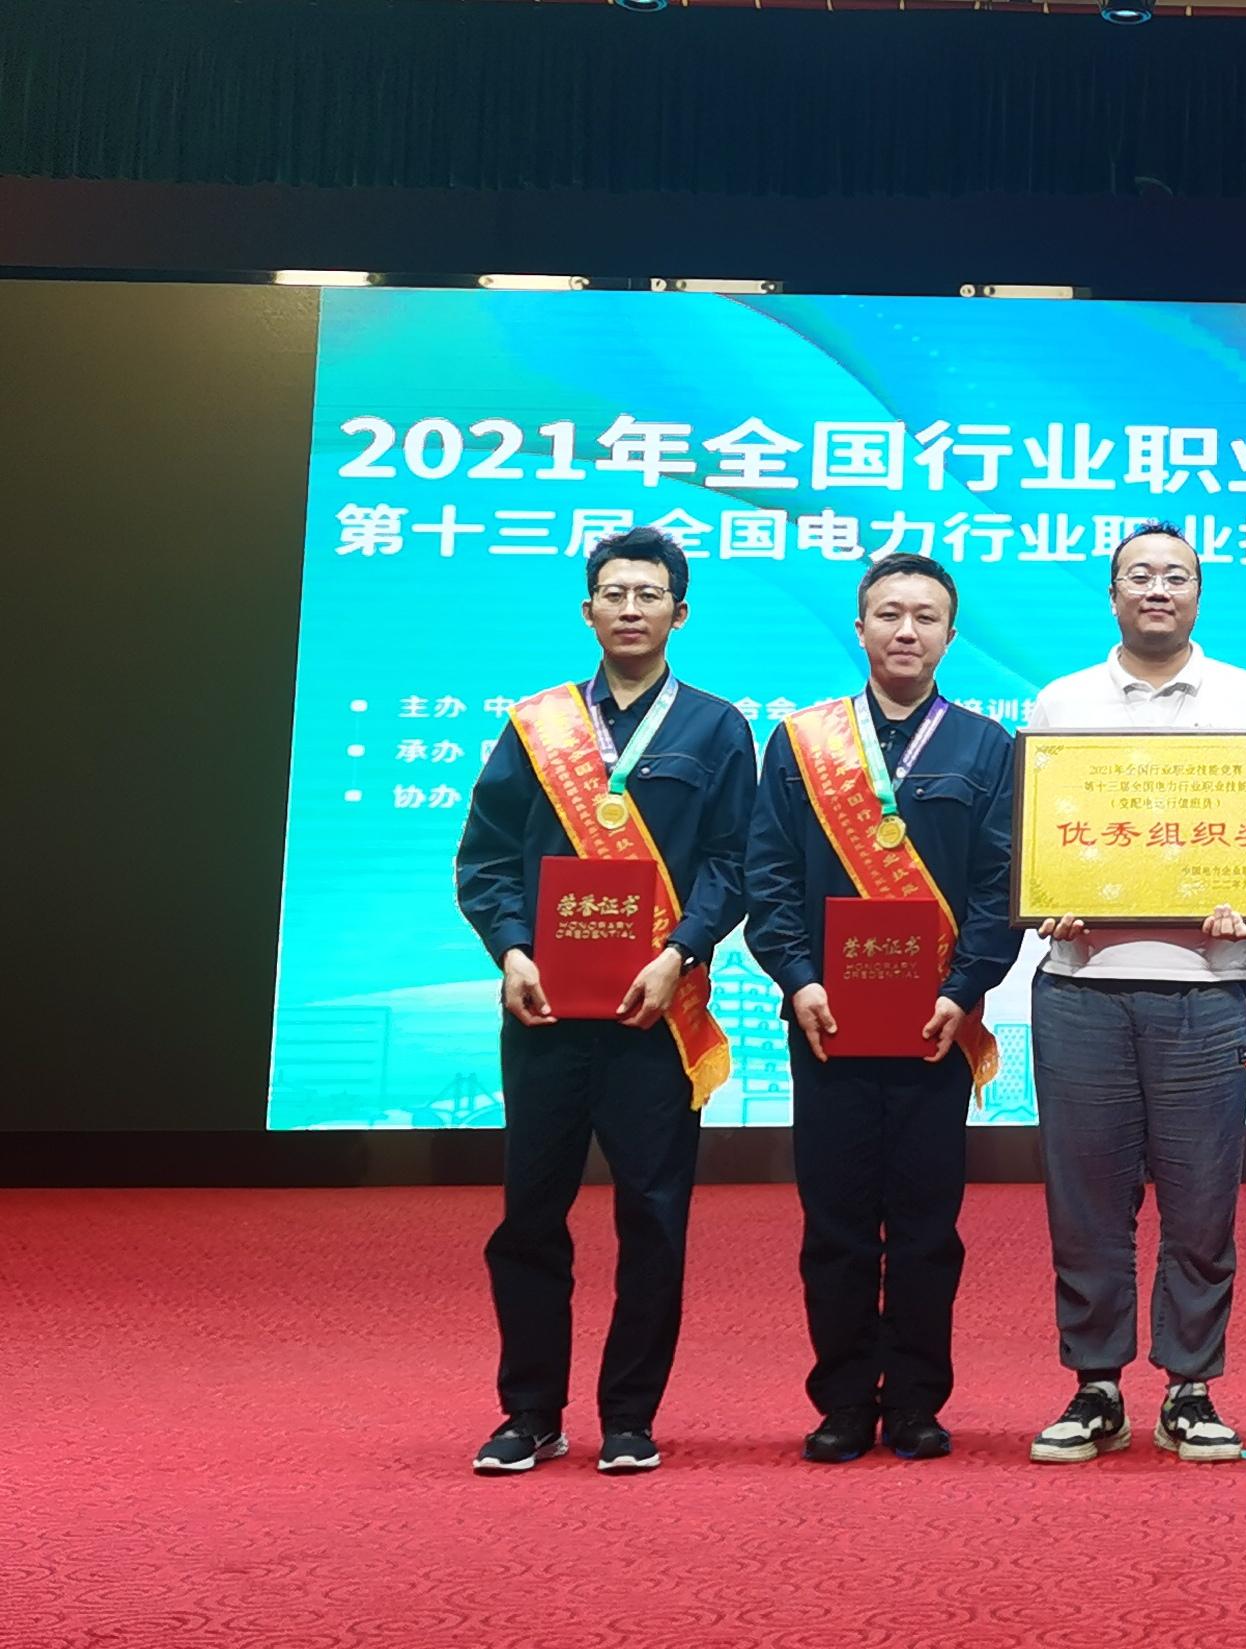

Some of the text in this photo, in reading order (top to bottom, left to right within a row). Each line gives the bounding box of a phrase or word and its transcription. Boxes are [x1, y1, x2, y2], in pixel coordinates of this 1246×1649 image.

[398, 695, 467, 718] 主办
[395, 739, 465, 763] 承办
[392, 784, 461, 809] 协办
[557, 892, 640, 917] 荣誉证书
